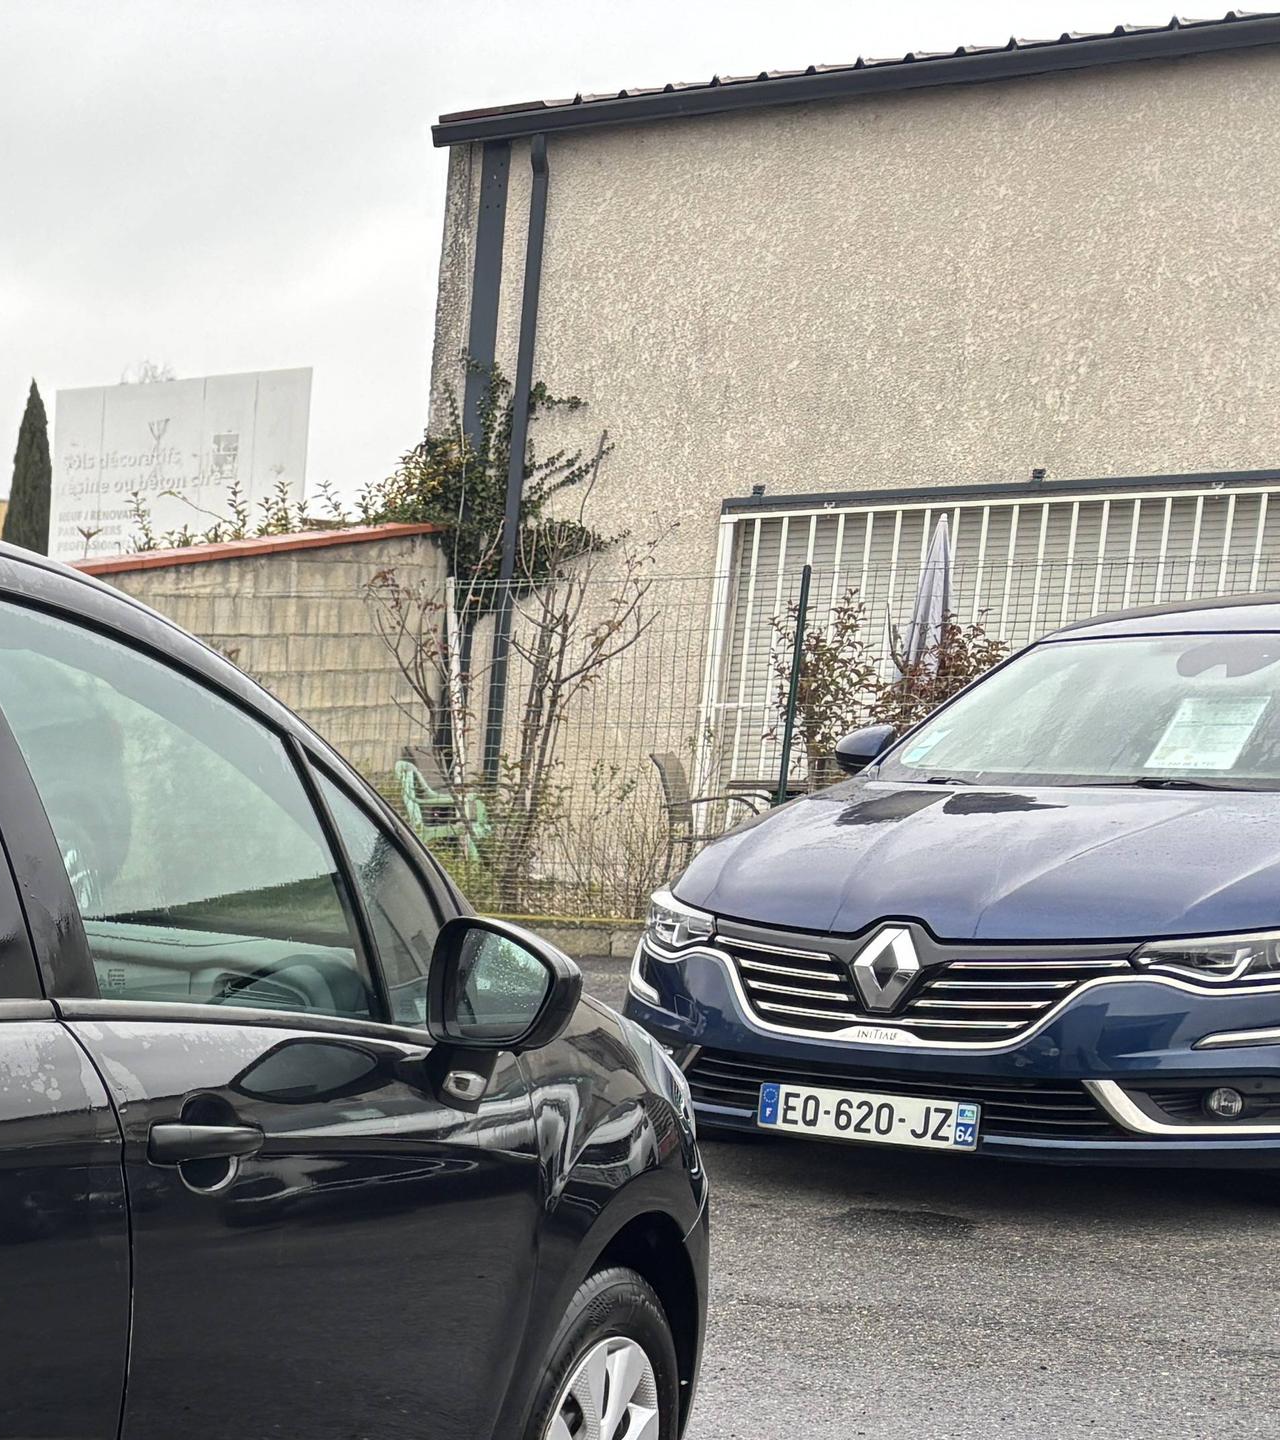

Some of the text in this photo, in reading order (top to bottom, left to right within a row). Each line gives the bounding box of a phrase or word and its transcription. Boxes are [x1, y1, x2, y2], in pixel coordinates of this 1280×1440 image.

[765, 1091, 974, 1143] F EQ-620-JZ 64
